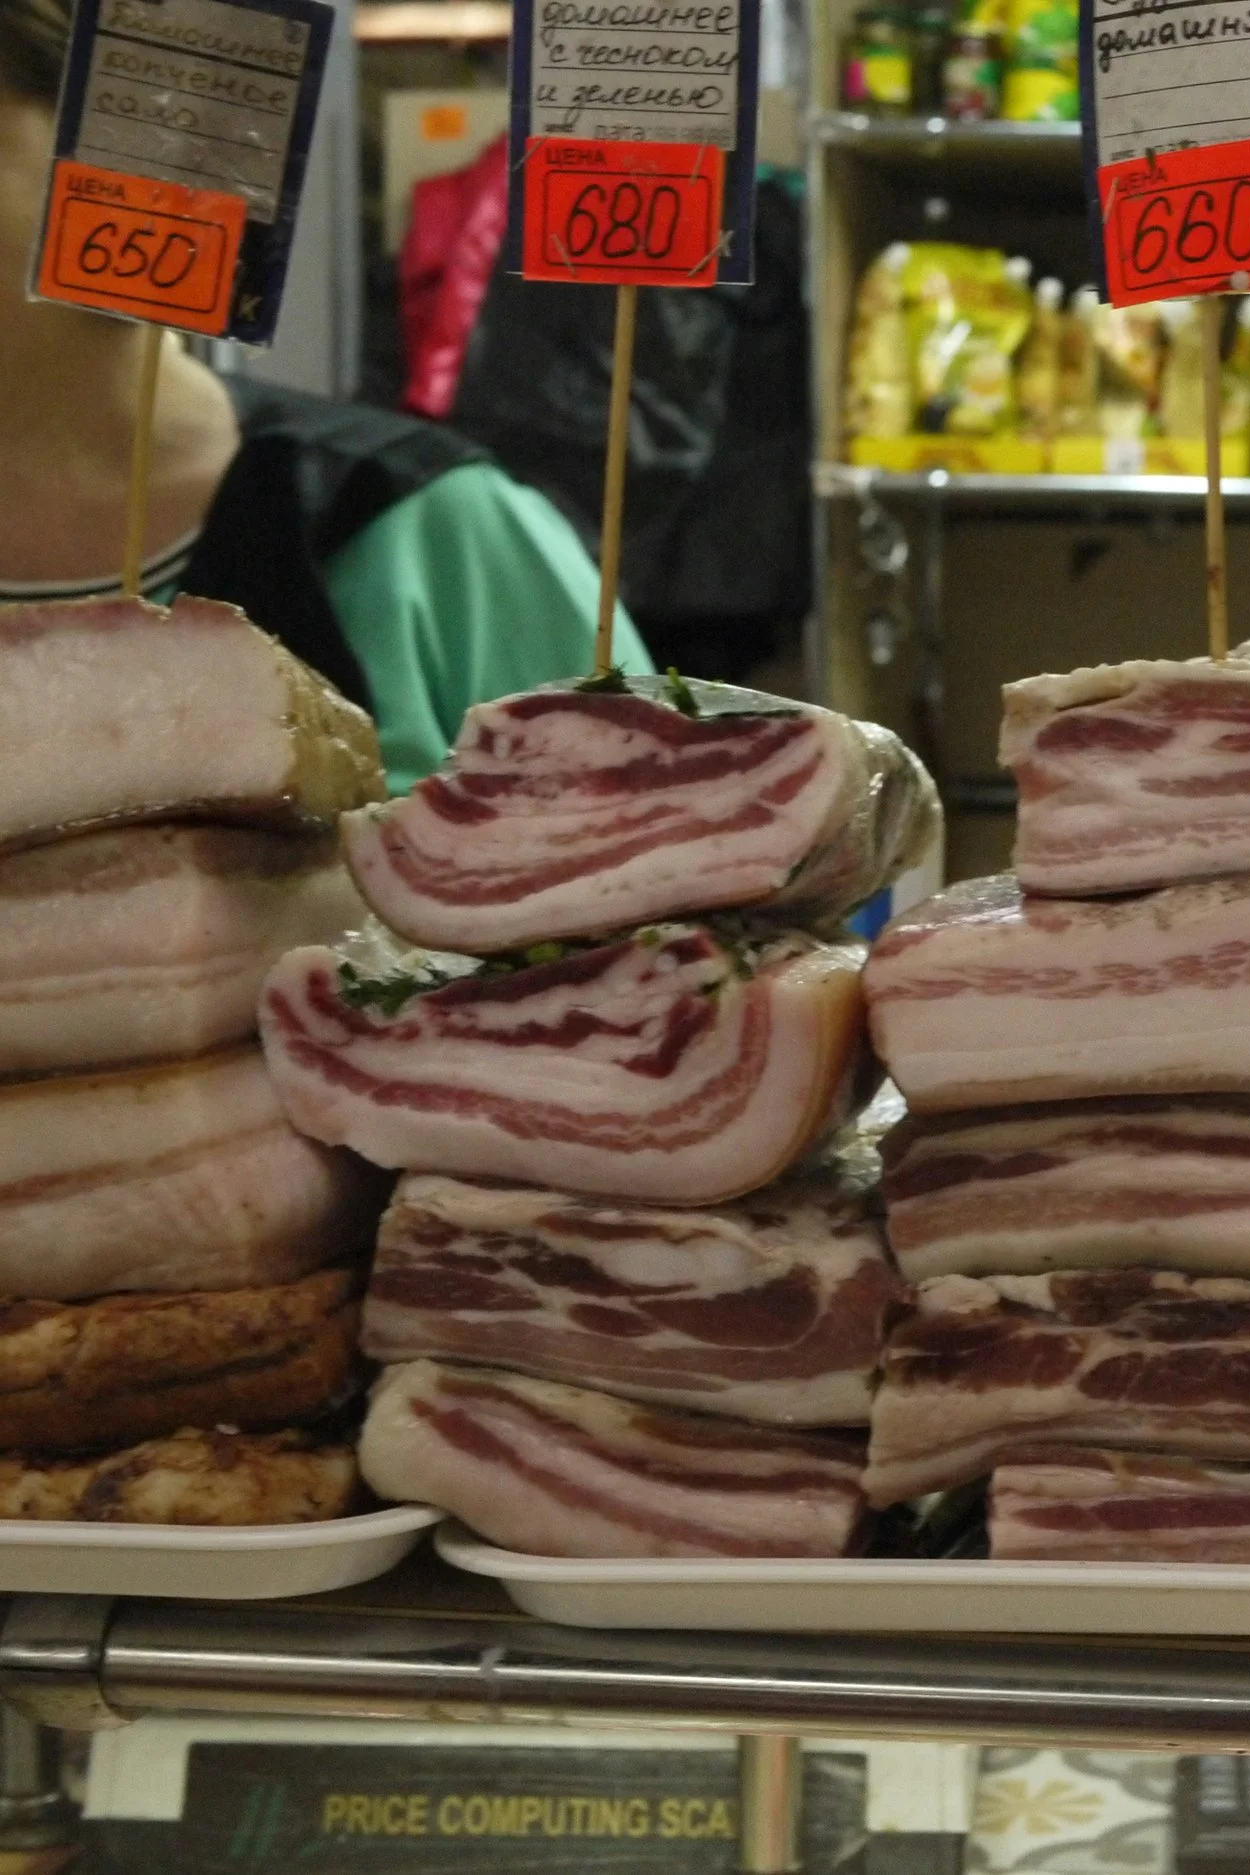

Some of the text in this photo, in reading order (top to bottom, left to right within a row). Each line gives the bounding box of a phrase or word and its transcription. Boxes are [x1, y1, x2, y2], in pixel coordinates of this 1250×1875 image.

[540, 2, 740, 47] домашнее
[550, 44, 567, 62] с
[537, 84, 723, 124] и зеленью
[547, 148, 606, 165] ЦЕНА
[68, 174, 127, 201] ЦЕНА
[1117, 168, 1168, 193] ЦЕНА
[567, 183, 681, 259] 680
[78, 222, 197, 289] 650
[323, 1794, 431, 1835] PRICE
[438, 1795, 651, 1838] COMPUTING
